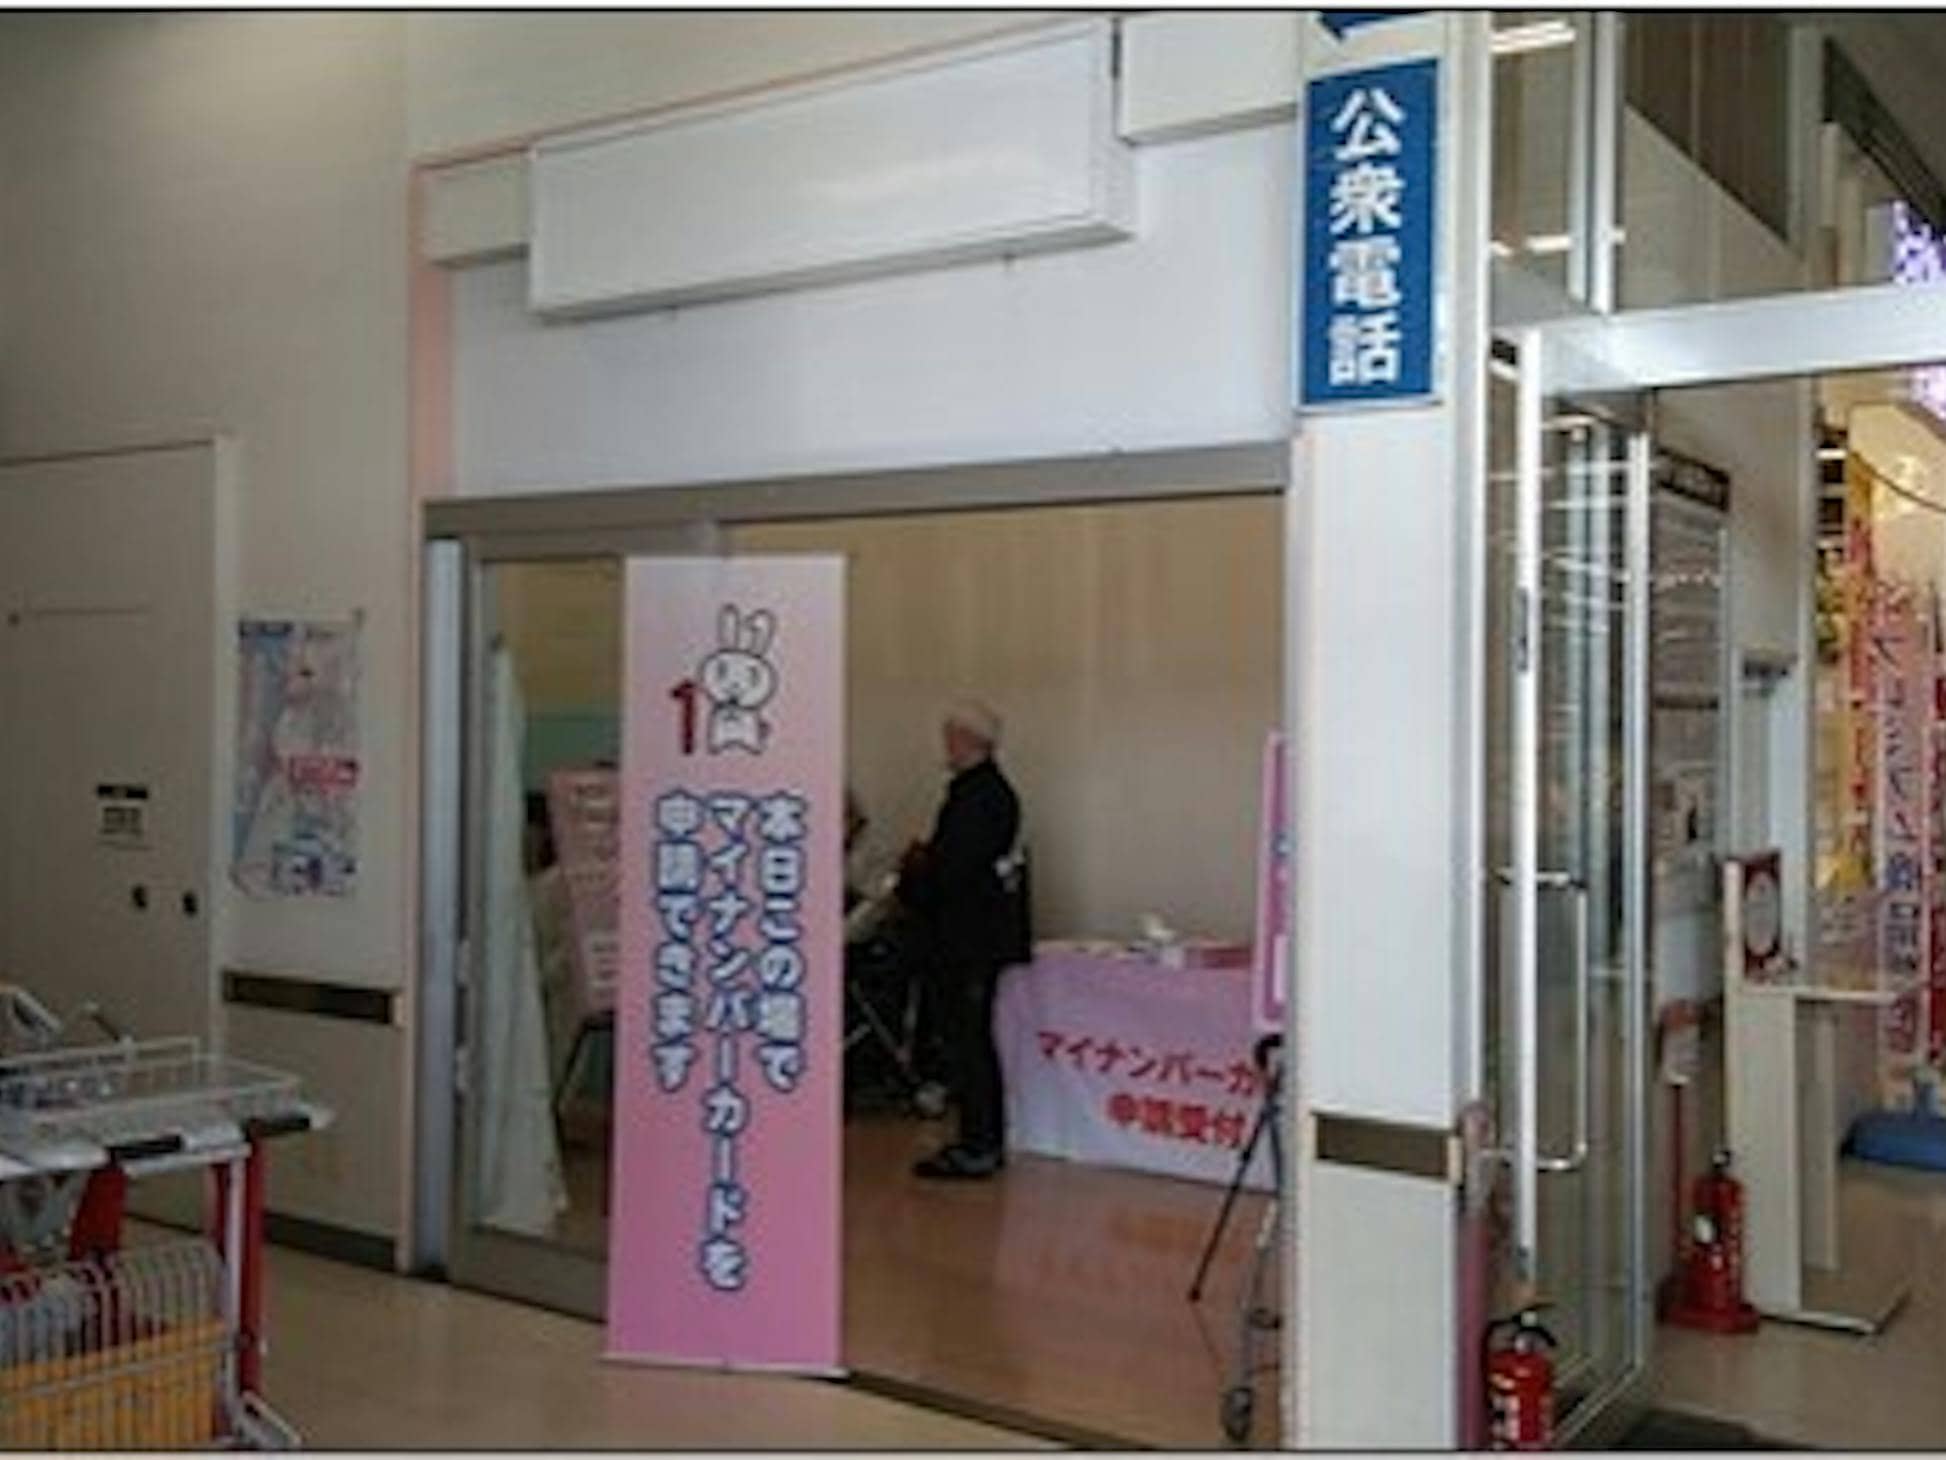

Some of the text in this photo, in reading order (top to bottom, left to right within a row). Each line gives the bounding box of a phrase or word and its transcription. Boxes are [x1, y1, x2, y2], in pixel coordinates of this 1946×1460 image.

[1329, 86, 1406, 387] 公衆電話
[703, 793, 753, 1289] マイナンバーカードを
